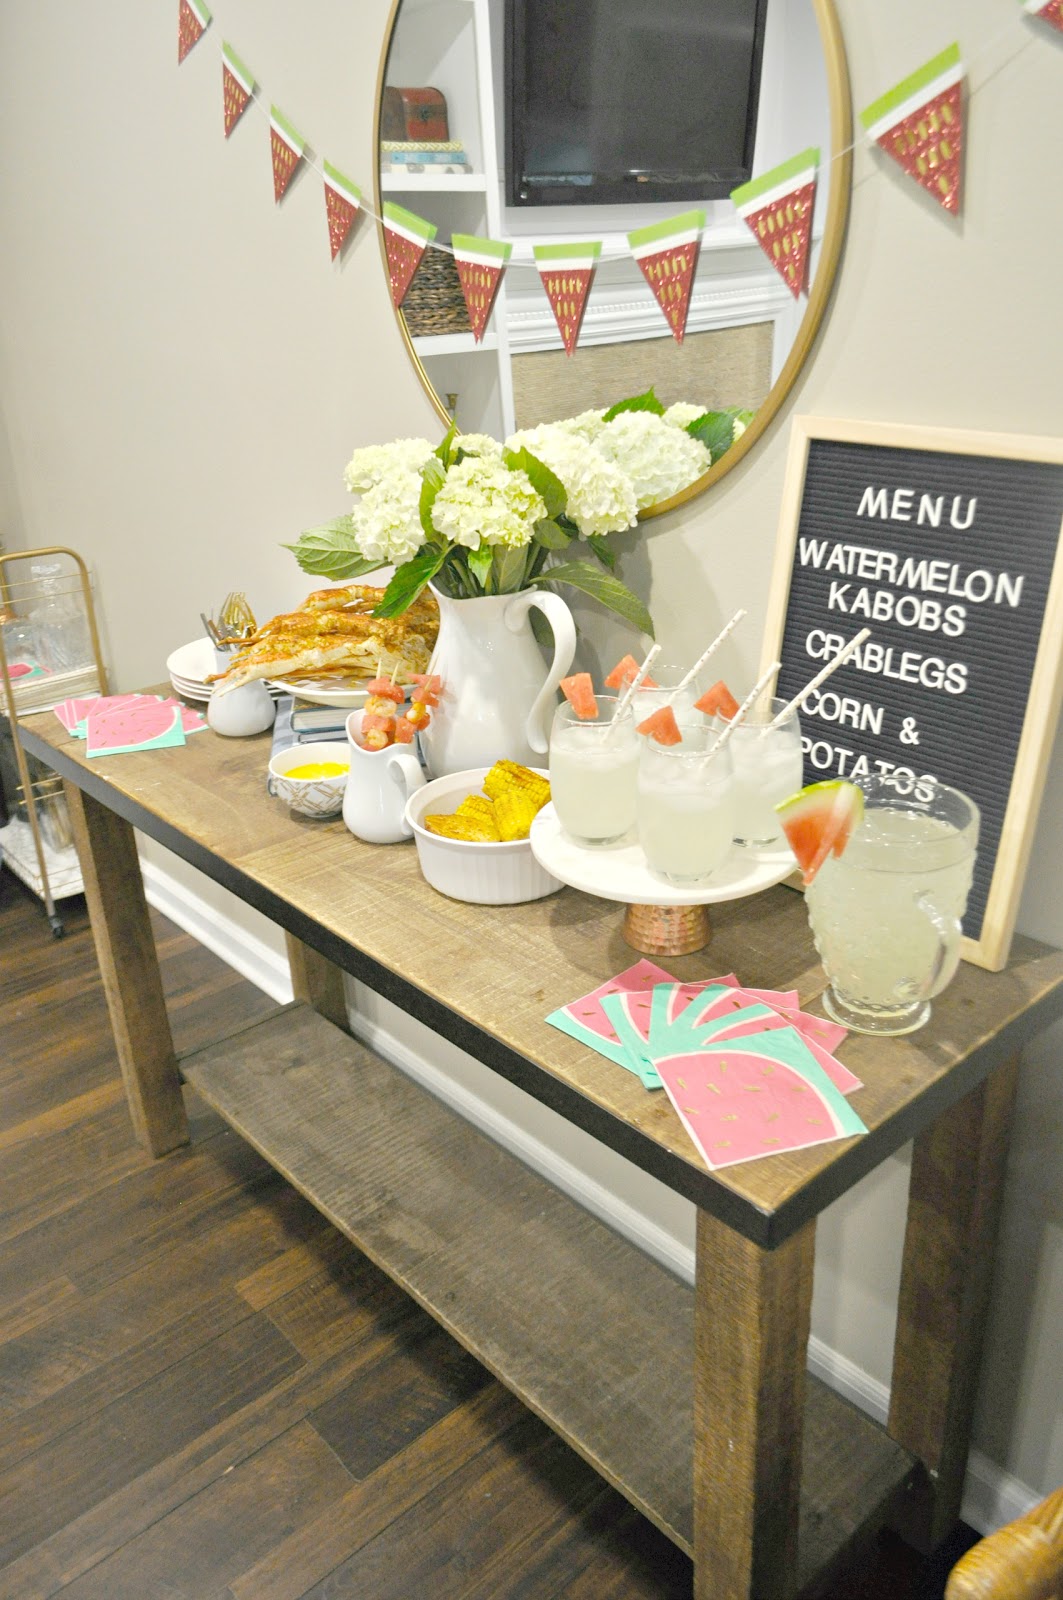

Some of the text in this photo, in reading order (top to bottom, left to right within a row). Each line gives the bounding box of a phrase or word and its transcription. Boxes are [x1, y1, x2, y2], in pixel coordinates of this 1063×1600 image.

[857, 486, 977, 529] MENU
[799, 537, 1024, 608] WATERMELON
[828, 581, 967, 637] KABOBS
[800, 689, 920, 745] CORN &
